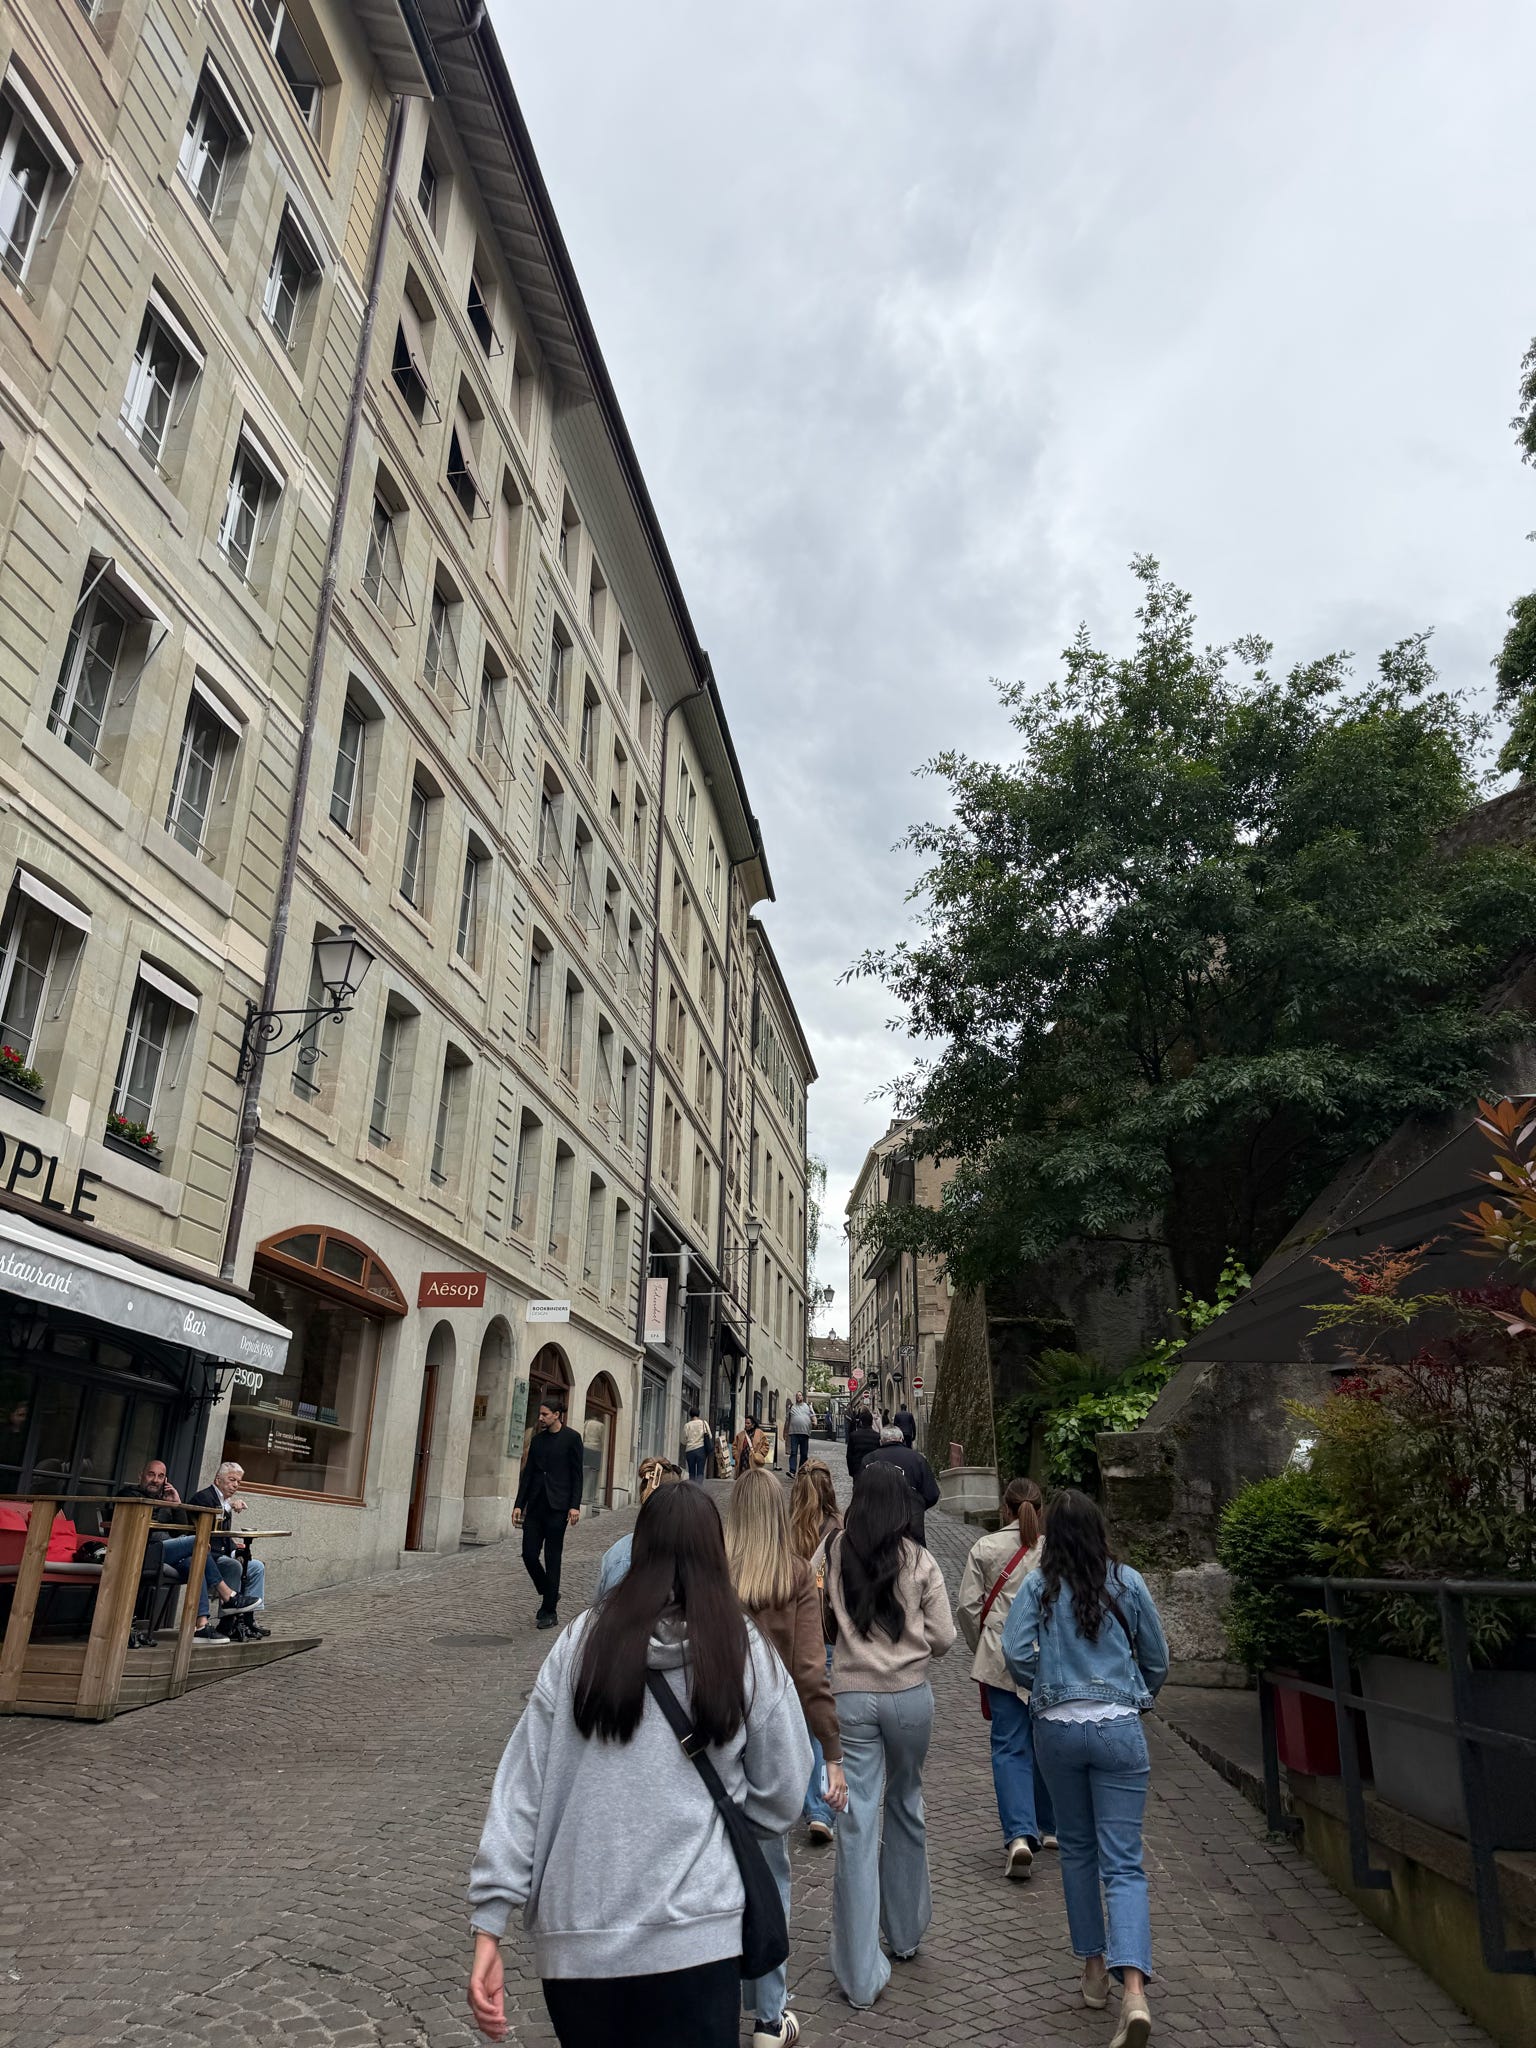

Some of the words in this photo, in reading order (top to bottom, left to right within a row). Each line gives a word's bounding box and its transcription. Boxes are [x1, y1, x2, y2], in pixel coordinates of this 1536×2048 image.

[0, 1131, 102, 1222] PLE
[183, 1310, 207, 1337] Bar
[240, 1335, 260, 1355] Depuis
[233, 1367, 264, 1396] esop
